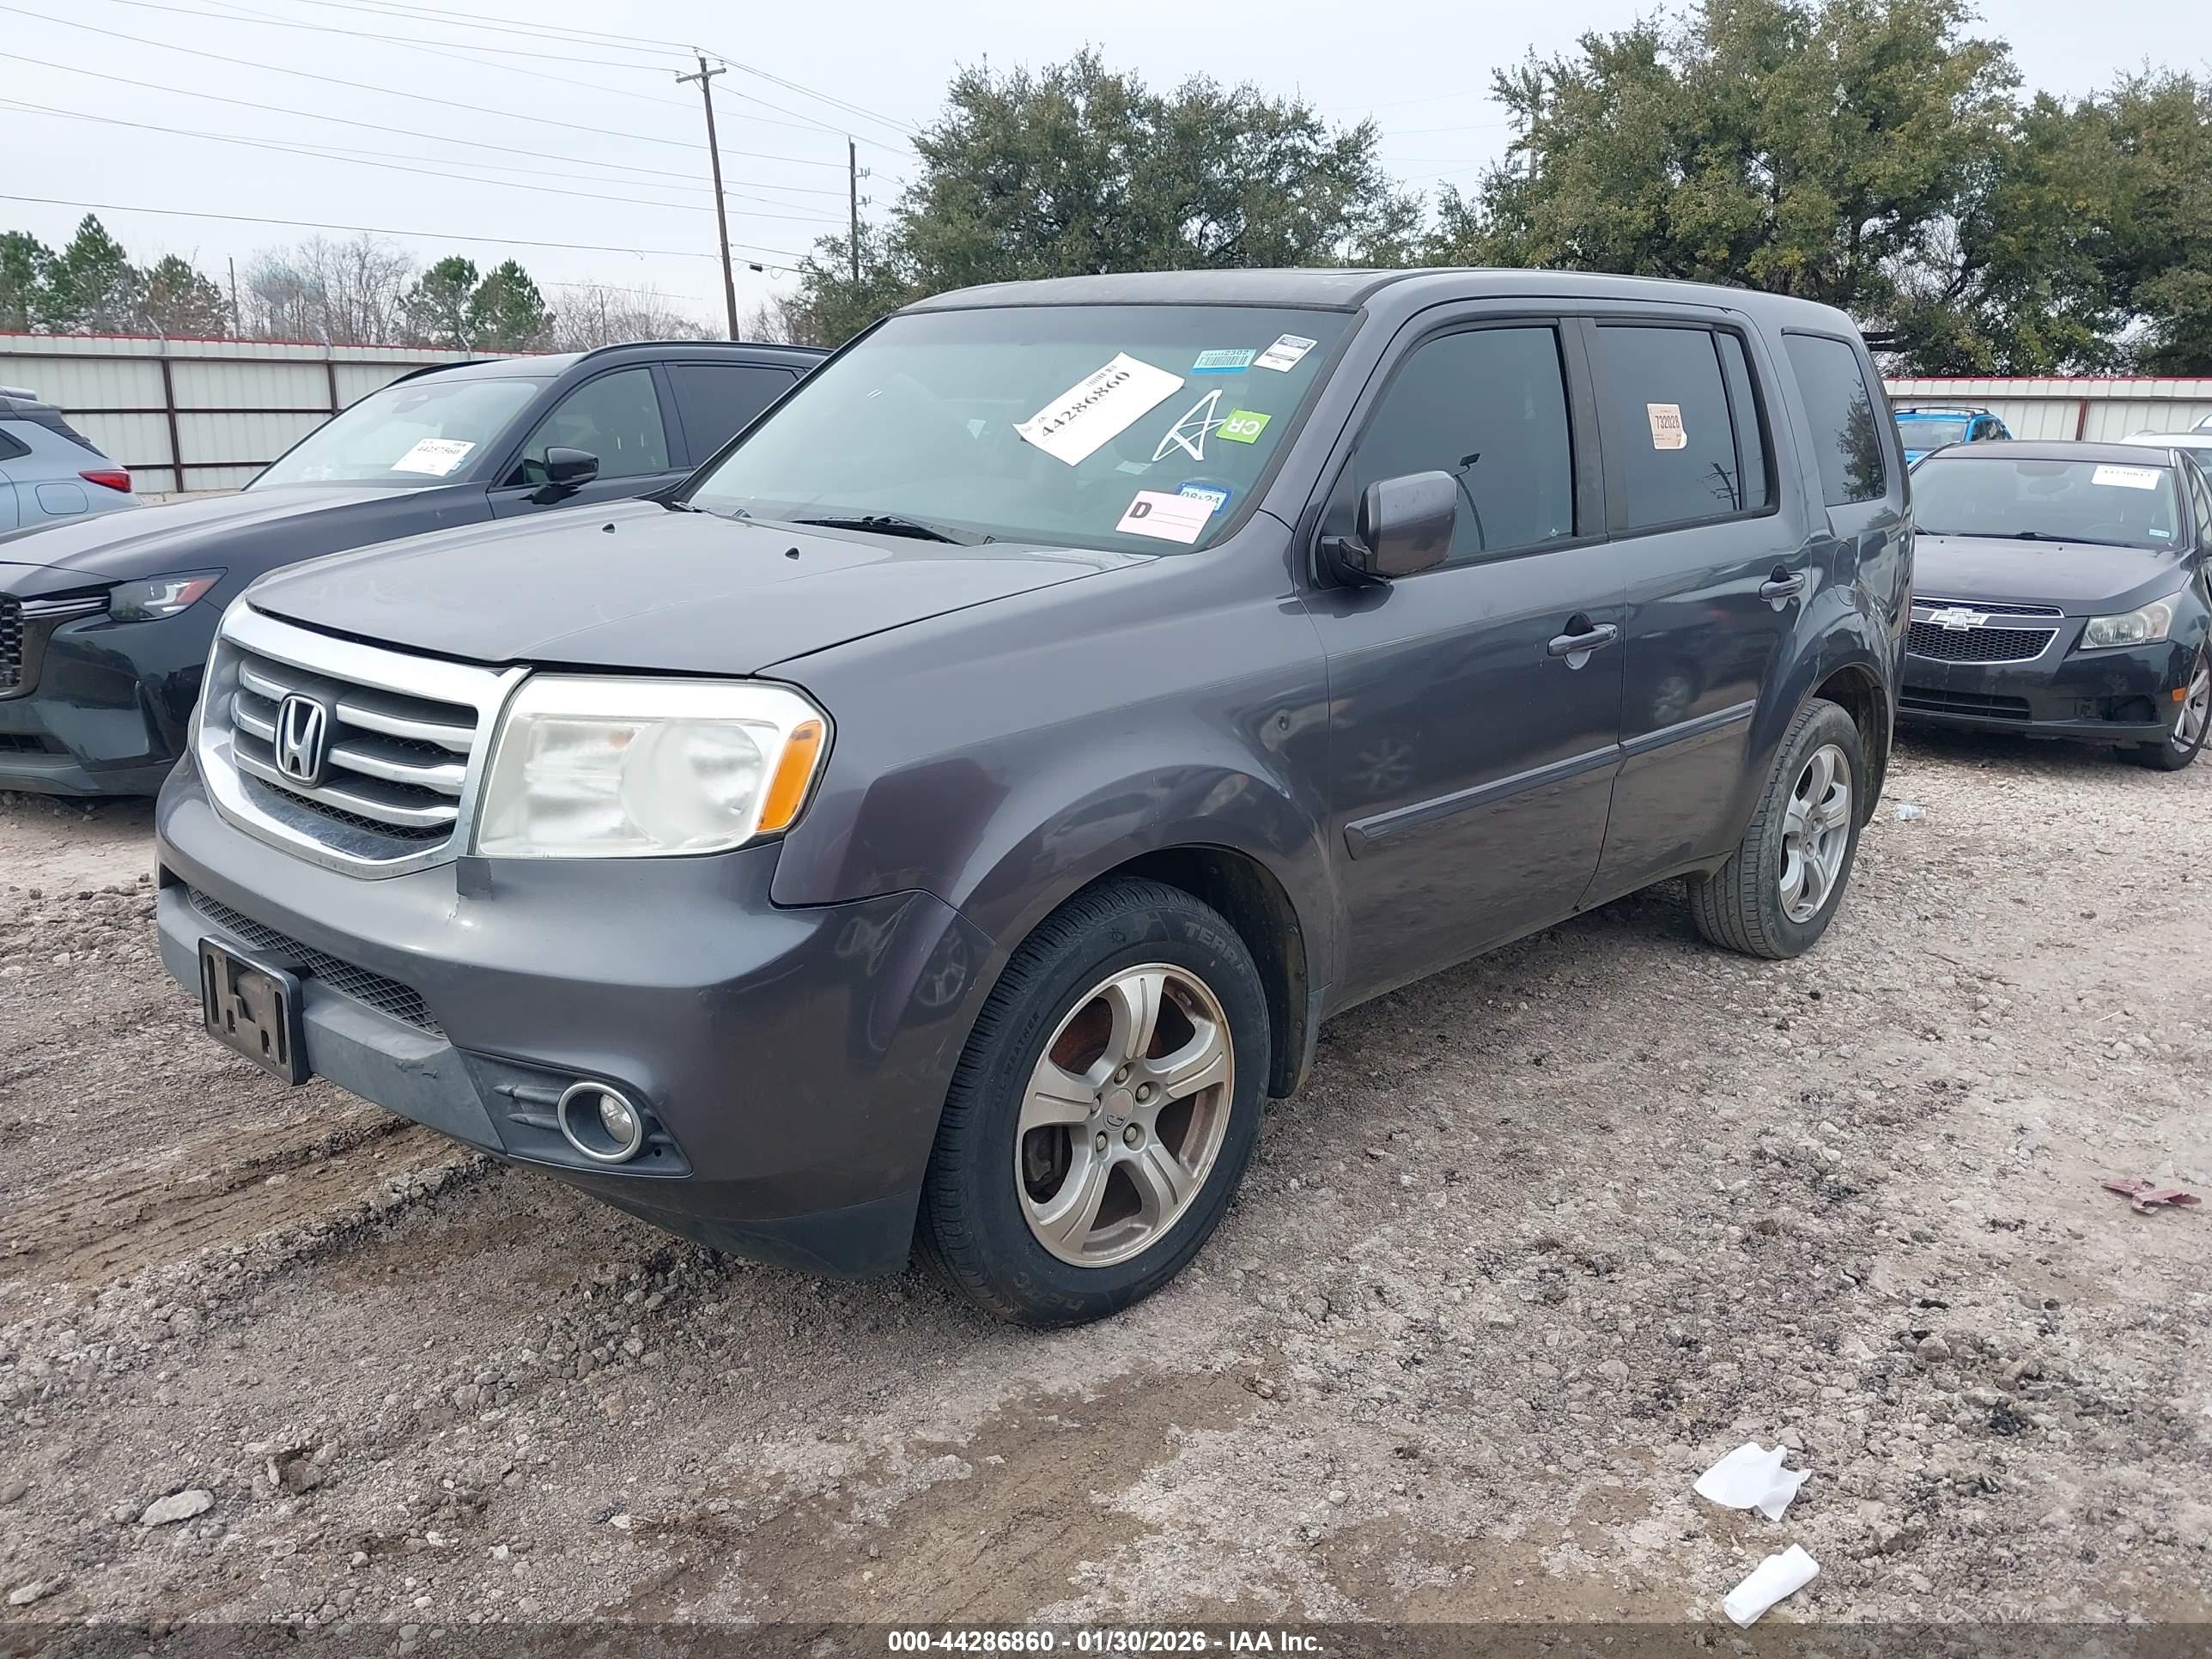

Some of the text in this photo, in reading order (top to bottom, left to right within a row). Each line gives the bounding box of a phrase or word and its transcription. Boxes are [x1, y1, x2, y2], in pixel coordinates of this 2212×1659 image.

[1040, 370, 1131, 438] 44286860
[1226, 416, 1261, 434] CR
[1655, 415, 1680, 429] 732028
[1128, 501, 1152, 519] D
